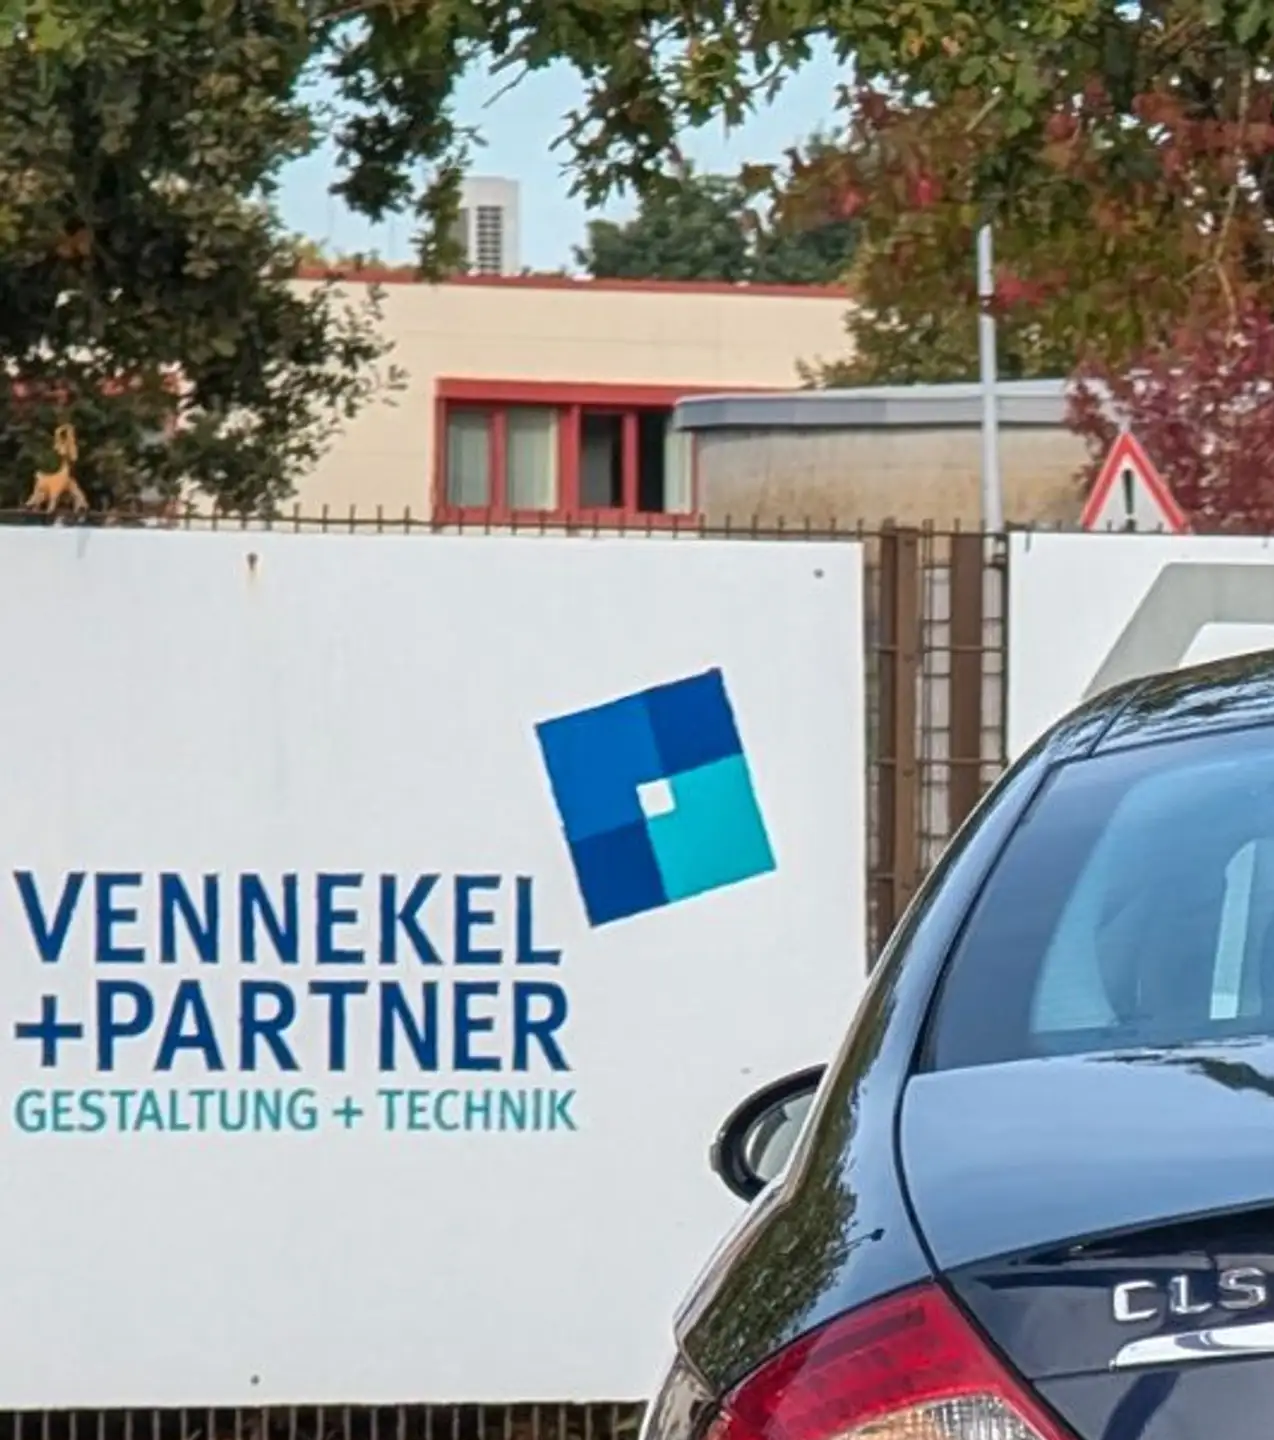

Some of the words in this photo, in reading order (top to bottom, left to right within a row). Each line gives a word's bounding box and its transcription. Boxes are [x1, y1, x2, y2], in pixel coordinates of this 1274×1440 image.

[14, 871, 563, 966] VENNEKEL
[15, 979, 571, 1072] +PARTNER
[15, 1089, 318, 1132] GESTALTUNG
[378, 1090, 577, 1131] TECHNIK
[1112, 1267, 1265, 1323] CLS
